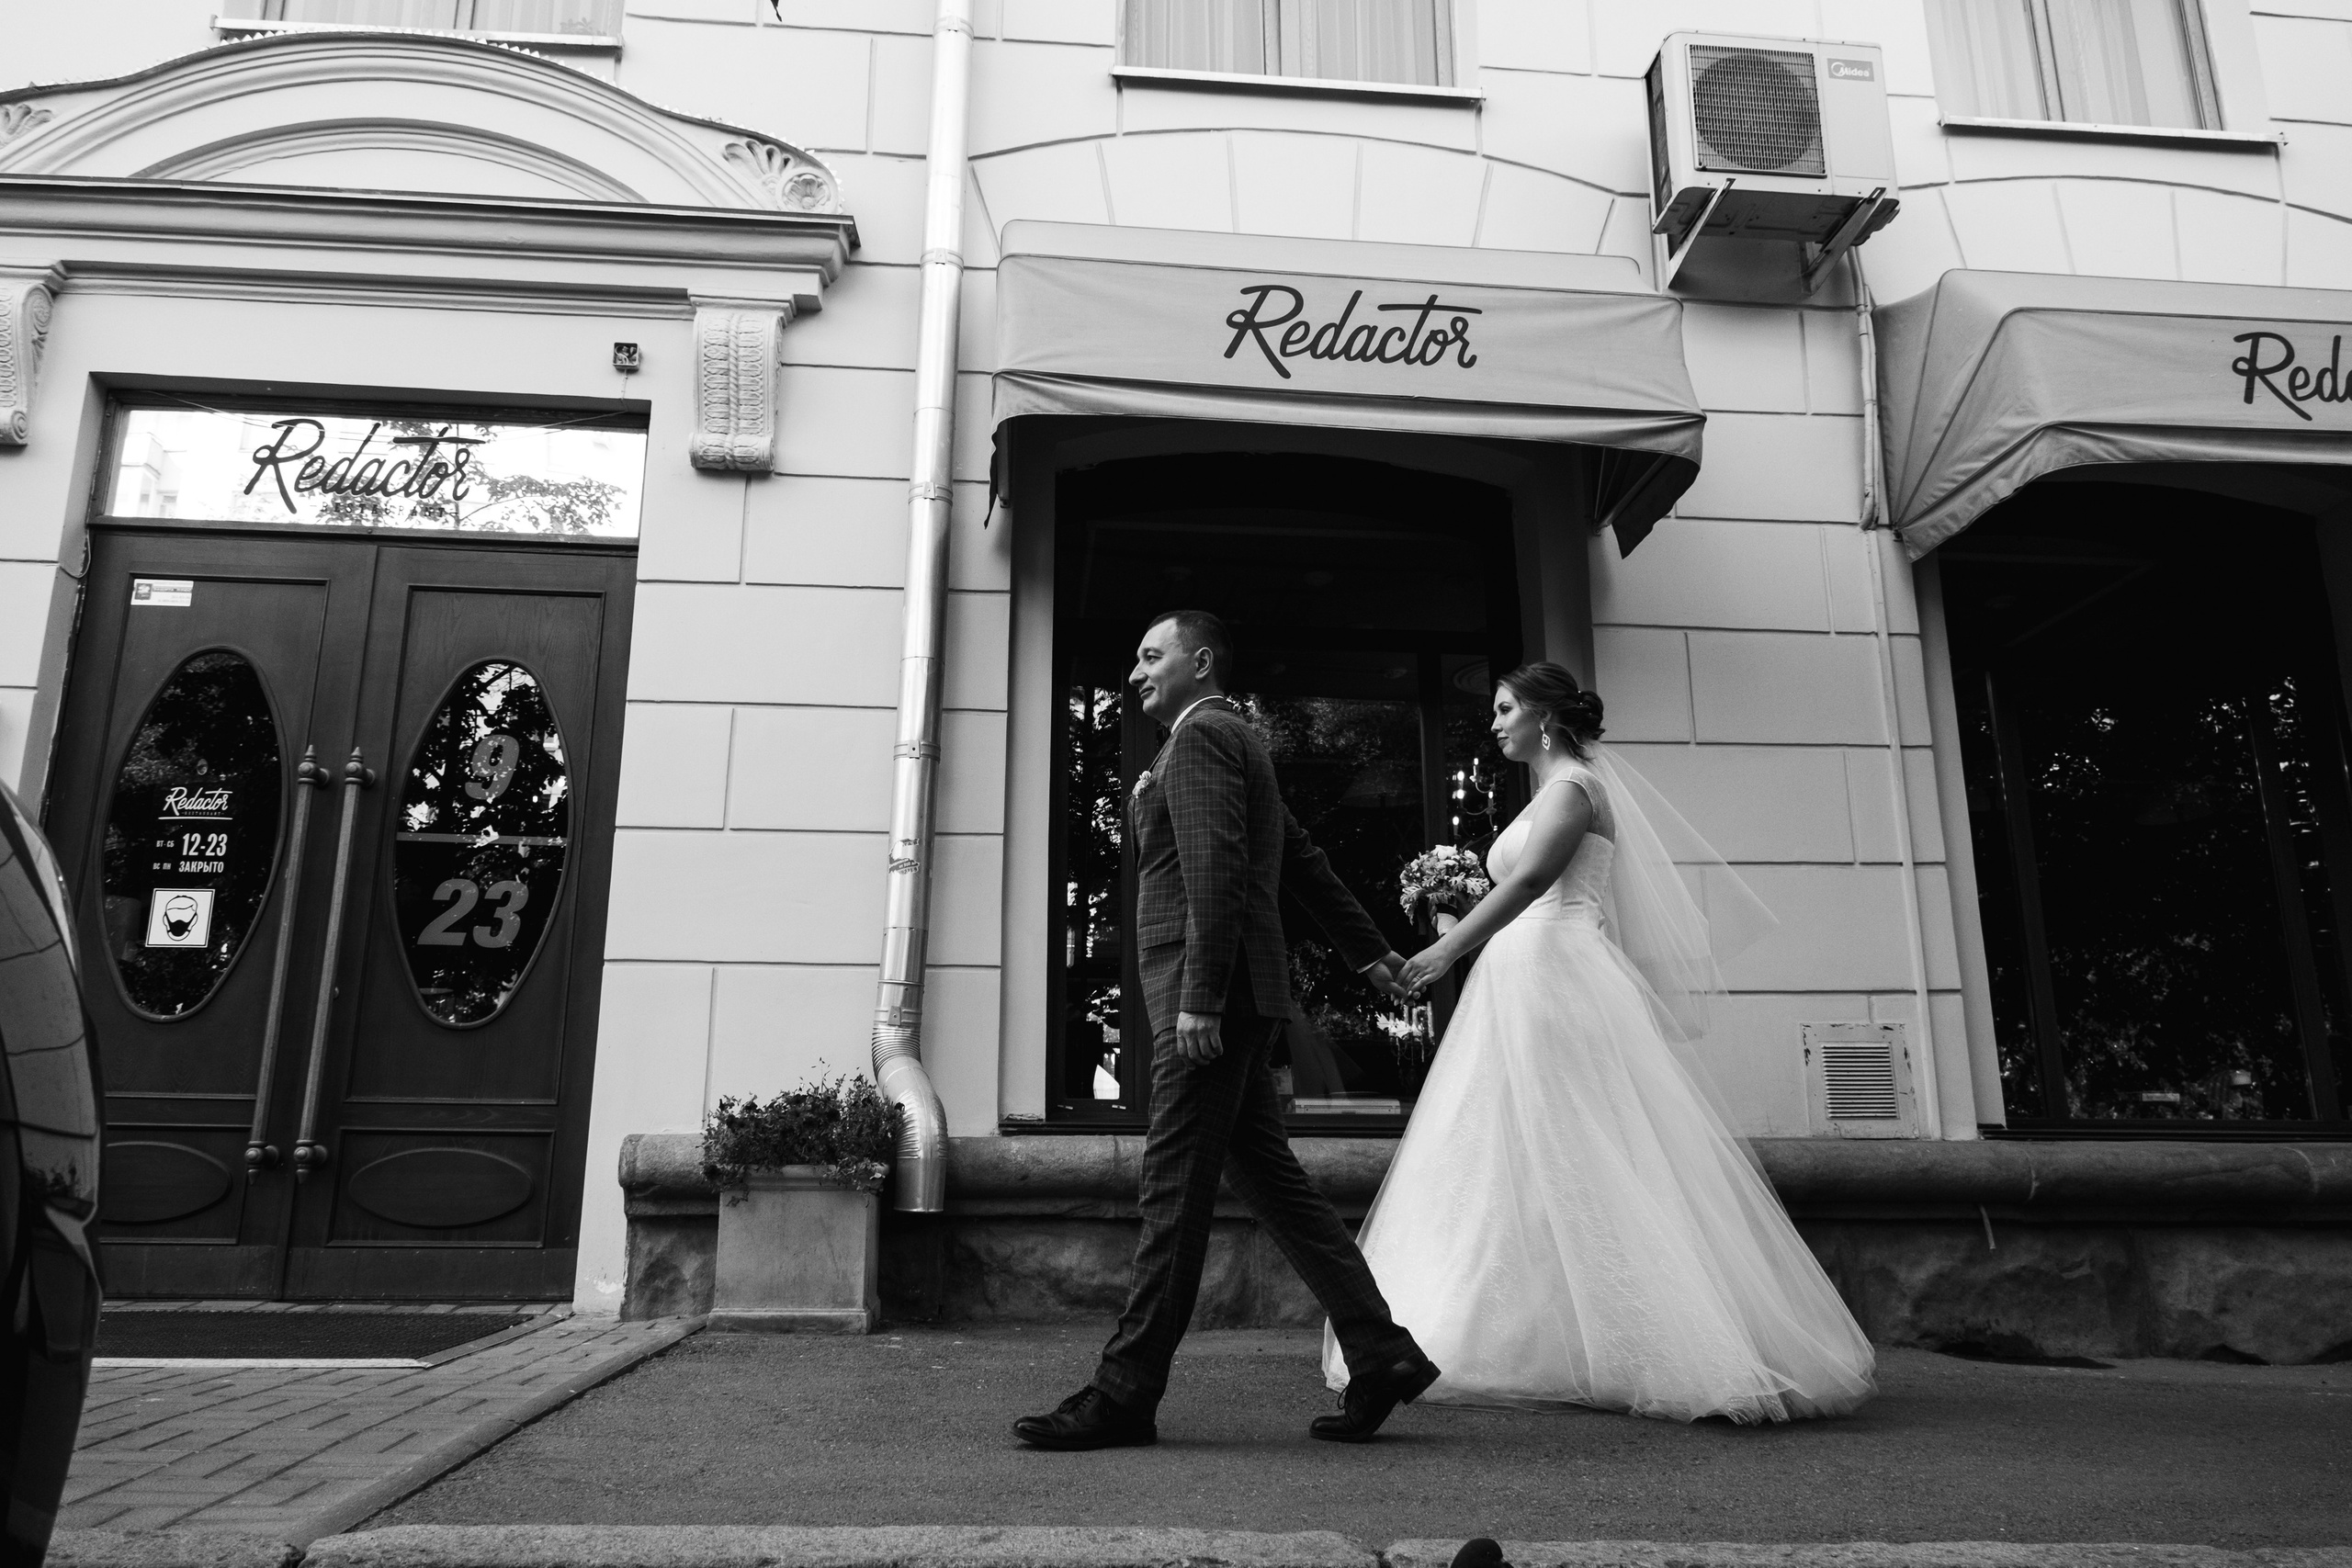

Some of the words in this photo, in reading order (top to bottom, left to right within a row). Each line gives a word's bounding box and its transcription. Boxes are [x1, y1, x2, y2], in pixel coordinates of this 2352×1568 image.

[1834, 63, 1870, 77] Midea
[1223, 284, 1483, 379] Redactor
[2231, 332, 2352, 422] Red
[243, 418, 487, 514] Redactor
[465, 735, 520, 800] 9
[163, 786, 233, 816] Redactor
[178, 861, 225, 874] ЗАКРЫТО
[182, 832, 229, 856] 12-23
[417, 878, 529, 949] 23
